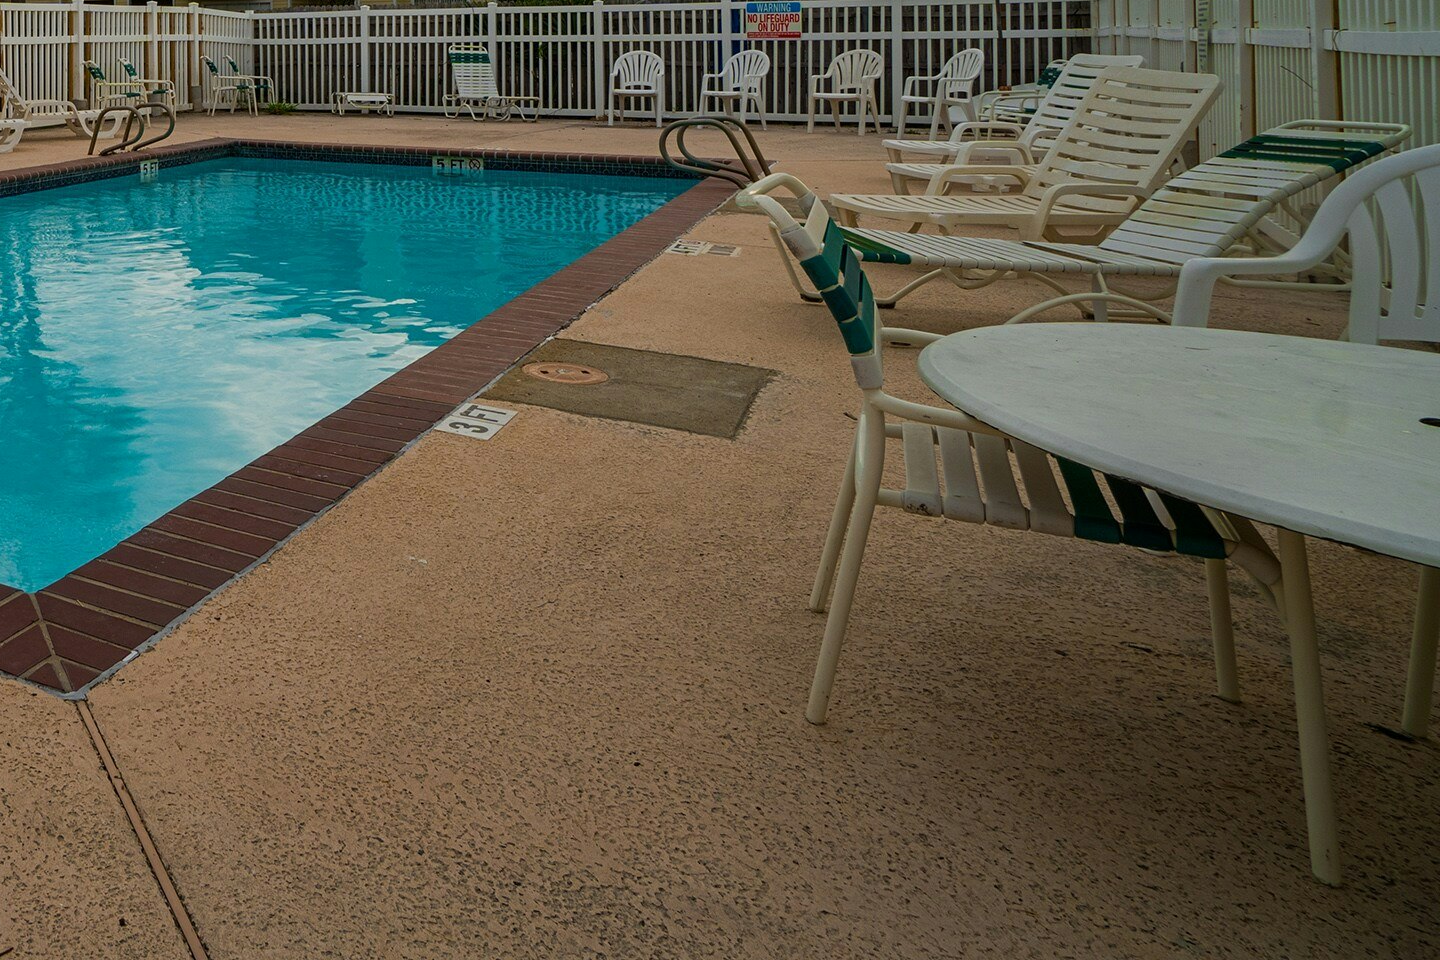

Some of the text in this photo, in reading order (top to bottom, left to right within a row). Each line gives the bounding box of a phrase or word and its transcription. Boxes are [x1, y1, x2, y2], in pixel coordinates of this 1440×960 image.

[756, 3, 791, 12] WARNING
[747, 14, 800, 23] NO LIFEGUARD
[757, 23, 790, 32] ON DUTY
[450, 159, 464, 169] FT
[448, 404, 507, 434] 3 FT
